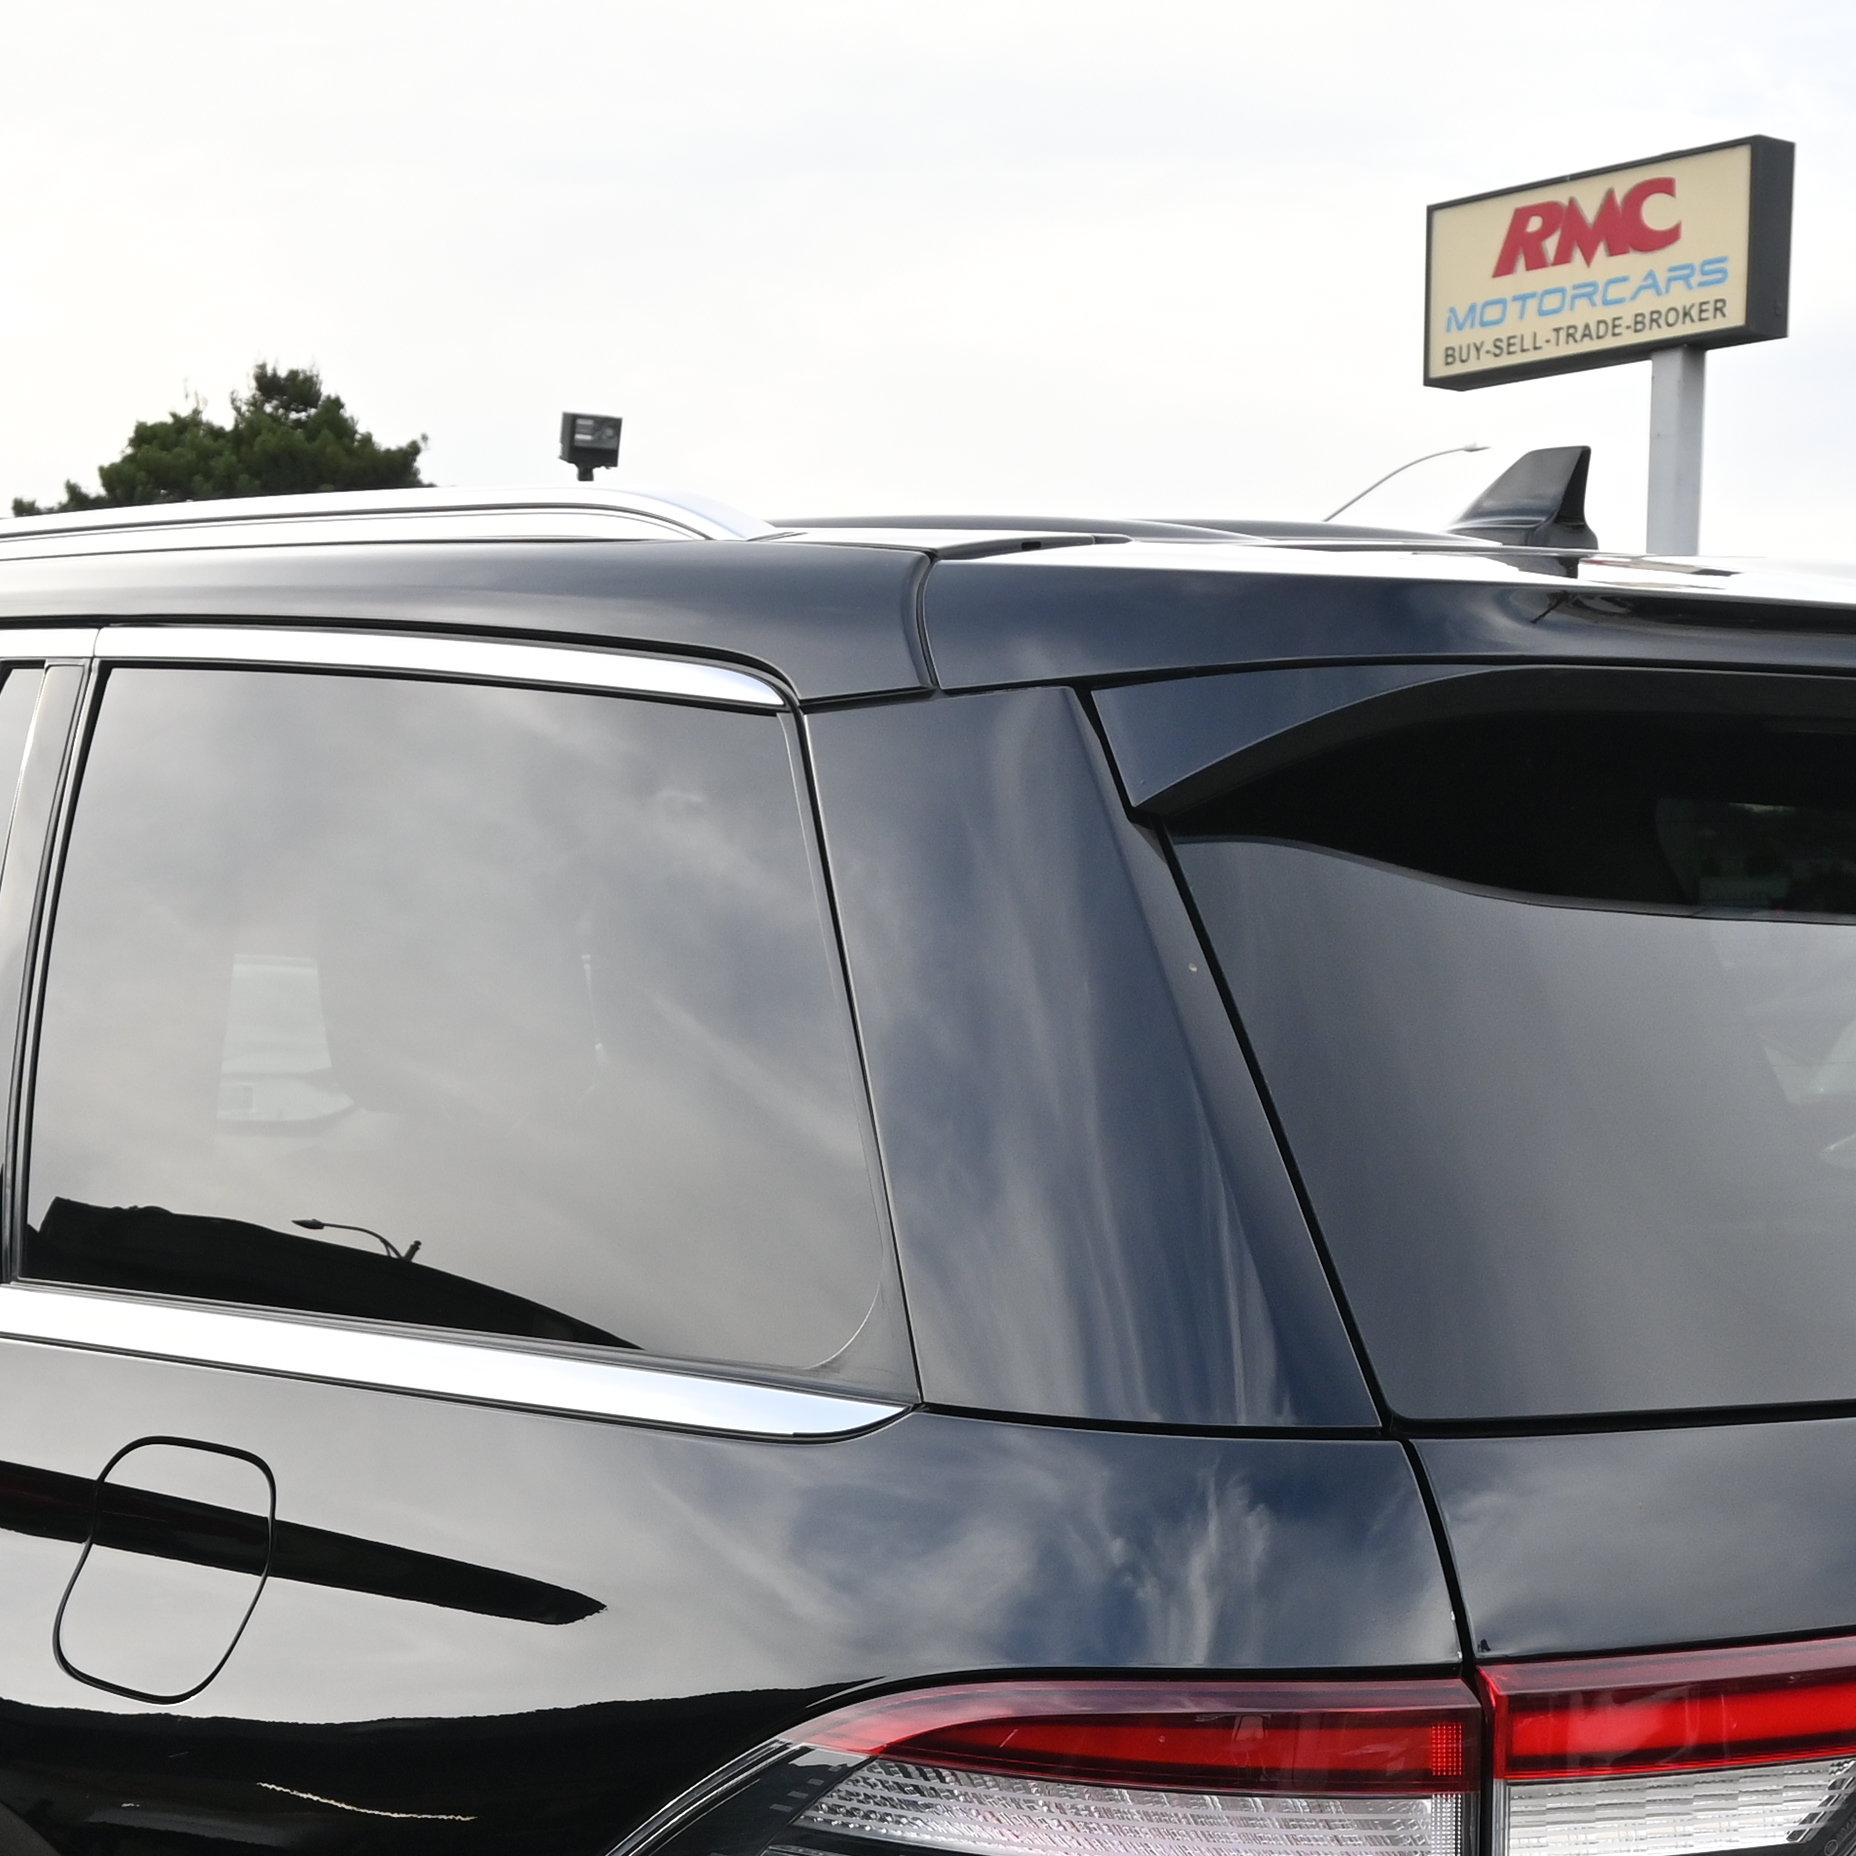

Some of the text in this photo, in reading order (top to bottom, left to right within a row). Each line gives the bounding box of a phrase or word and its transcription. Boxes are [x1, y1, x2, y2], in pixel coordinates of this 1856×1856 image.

[1491, 176, 1682, 279] RMC
[1444, 298, 1727, 366] BUY-SELL-TRADE-BROKER
[1446, 255, 1730, 333] MOTORCARS
